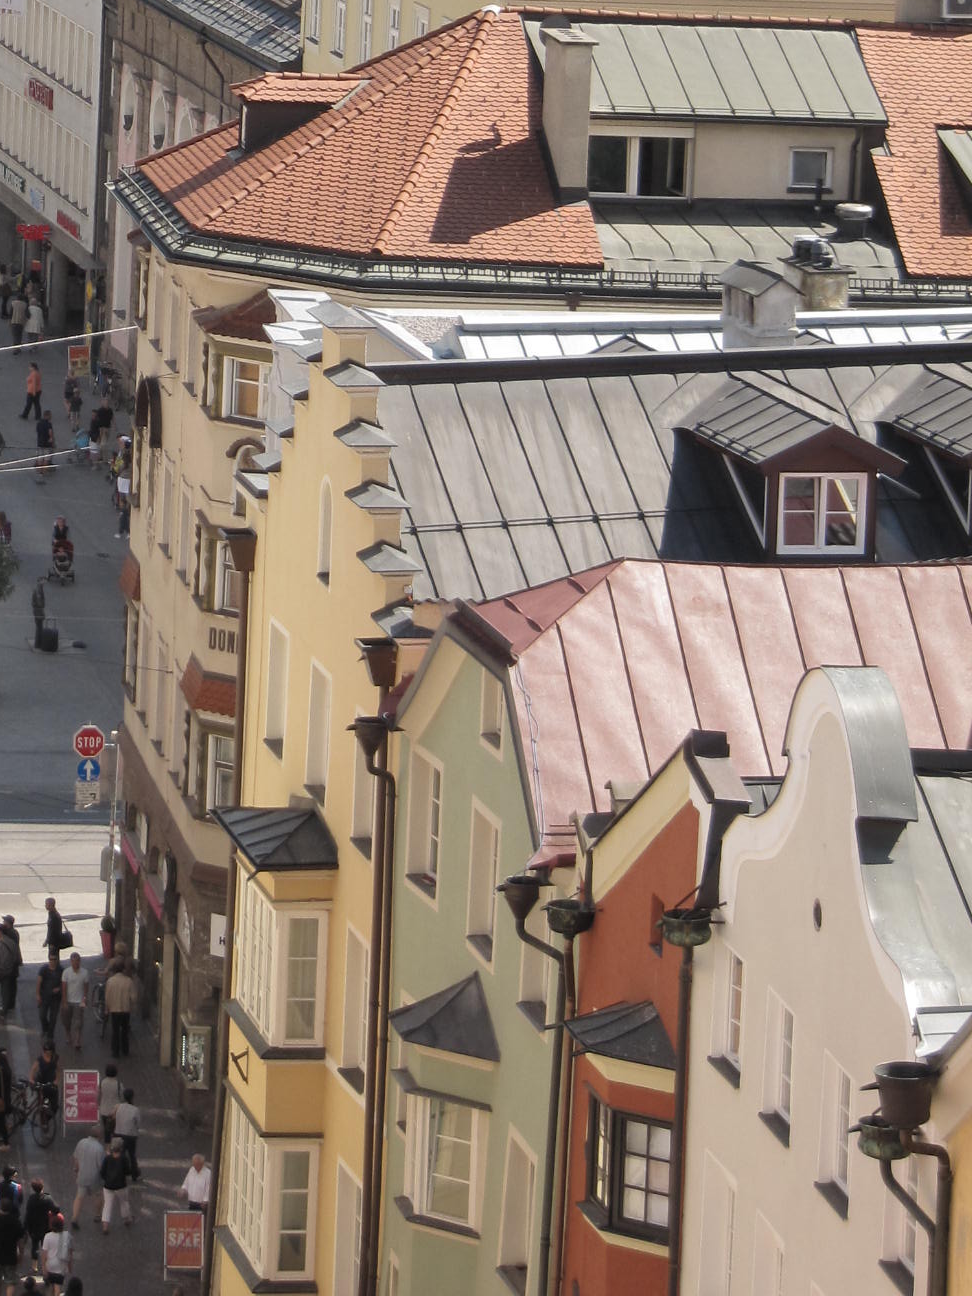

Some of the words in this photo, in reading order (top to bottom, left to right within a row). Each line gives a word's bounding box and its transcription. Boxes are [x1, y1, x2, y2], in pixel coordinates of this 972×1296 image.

[209, 627, 239, 654] DON
[77, 736, 102, 748] STOP
[66, 1073, 78, 1118] SALE
[168, 1232, 200, 1248] SALE
